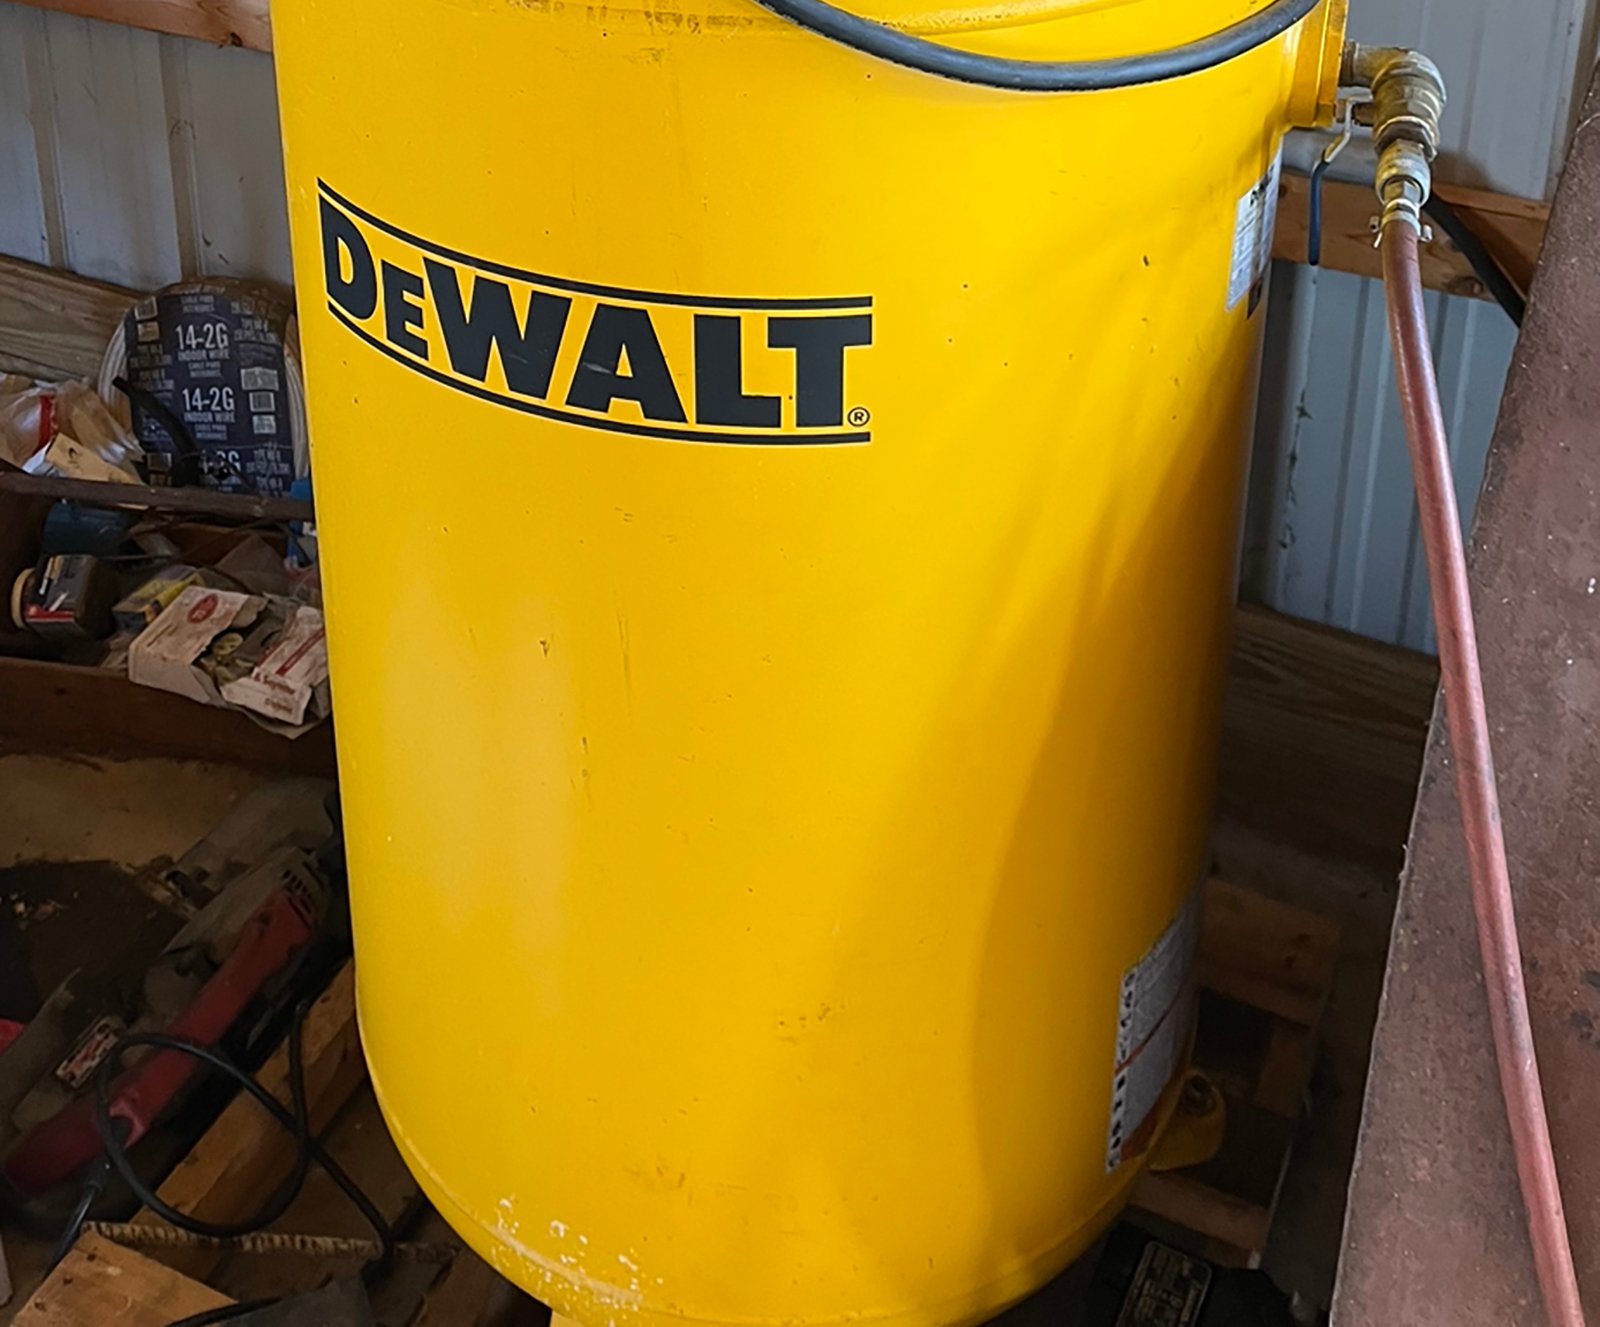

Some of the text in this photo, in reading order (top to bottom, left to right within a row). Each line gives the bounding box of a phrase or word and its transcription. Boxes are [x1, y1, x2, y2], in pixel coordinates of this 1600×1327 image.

[318, 193, 873, 428] DEWALT
[176, 323, 229, 350] 14-2G
[208, 349, 230, 360] WIRE
[182, 387, 235, 411] 14-2G
[214, 412, 235, 423] WIRE
